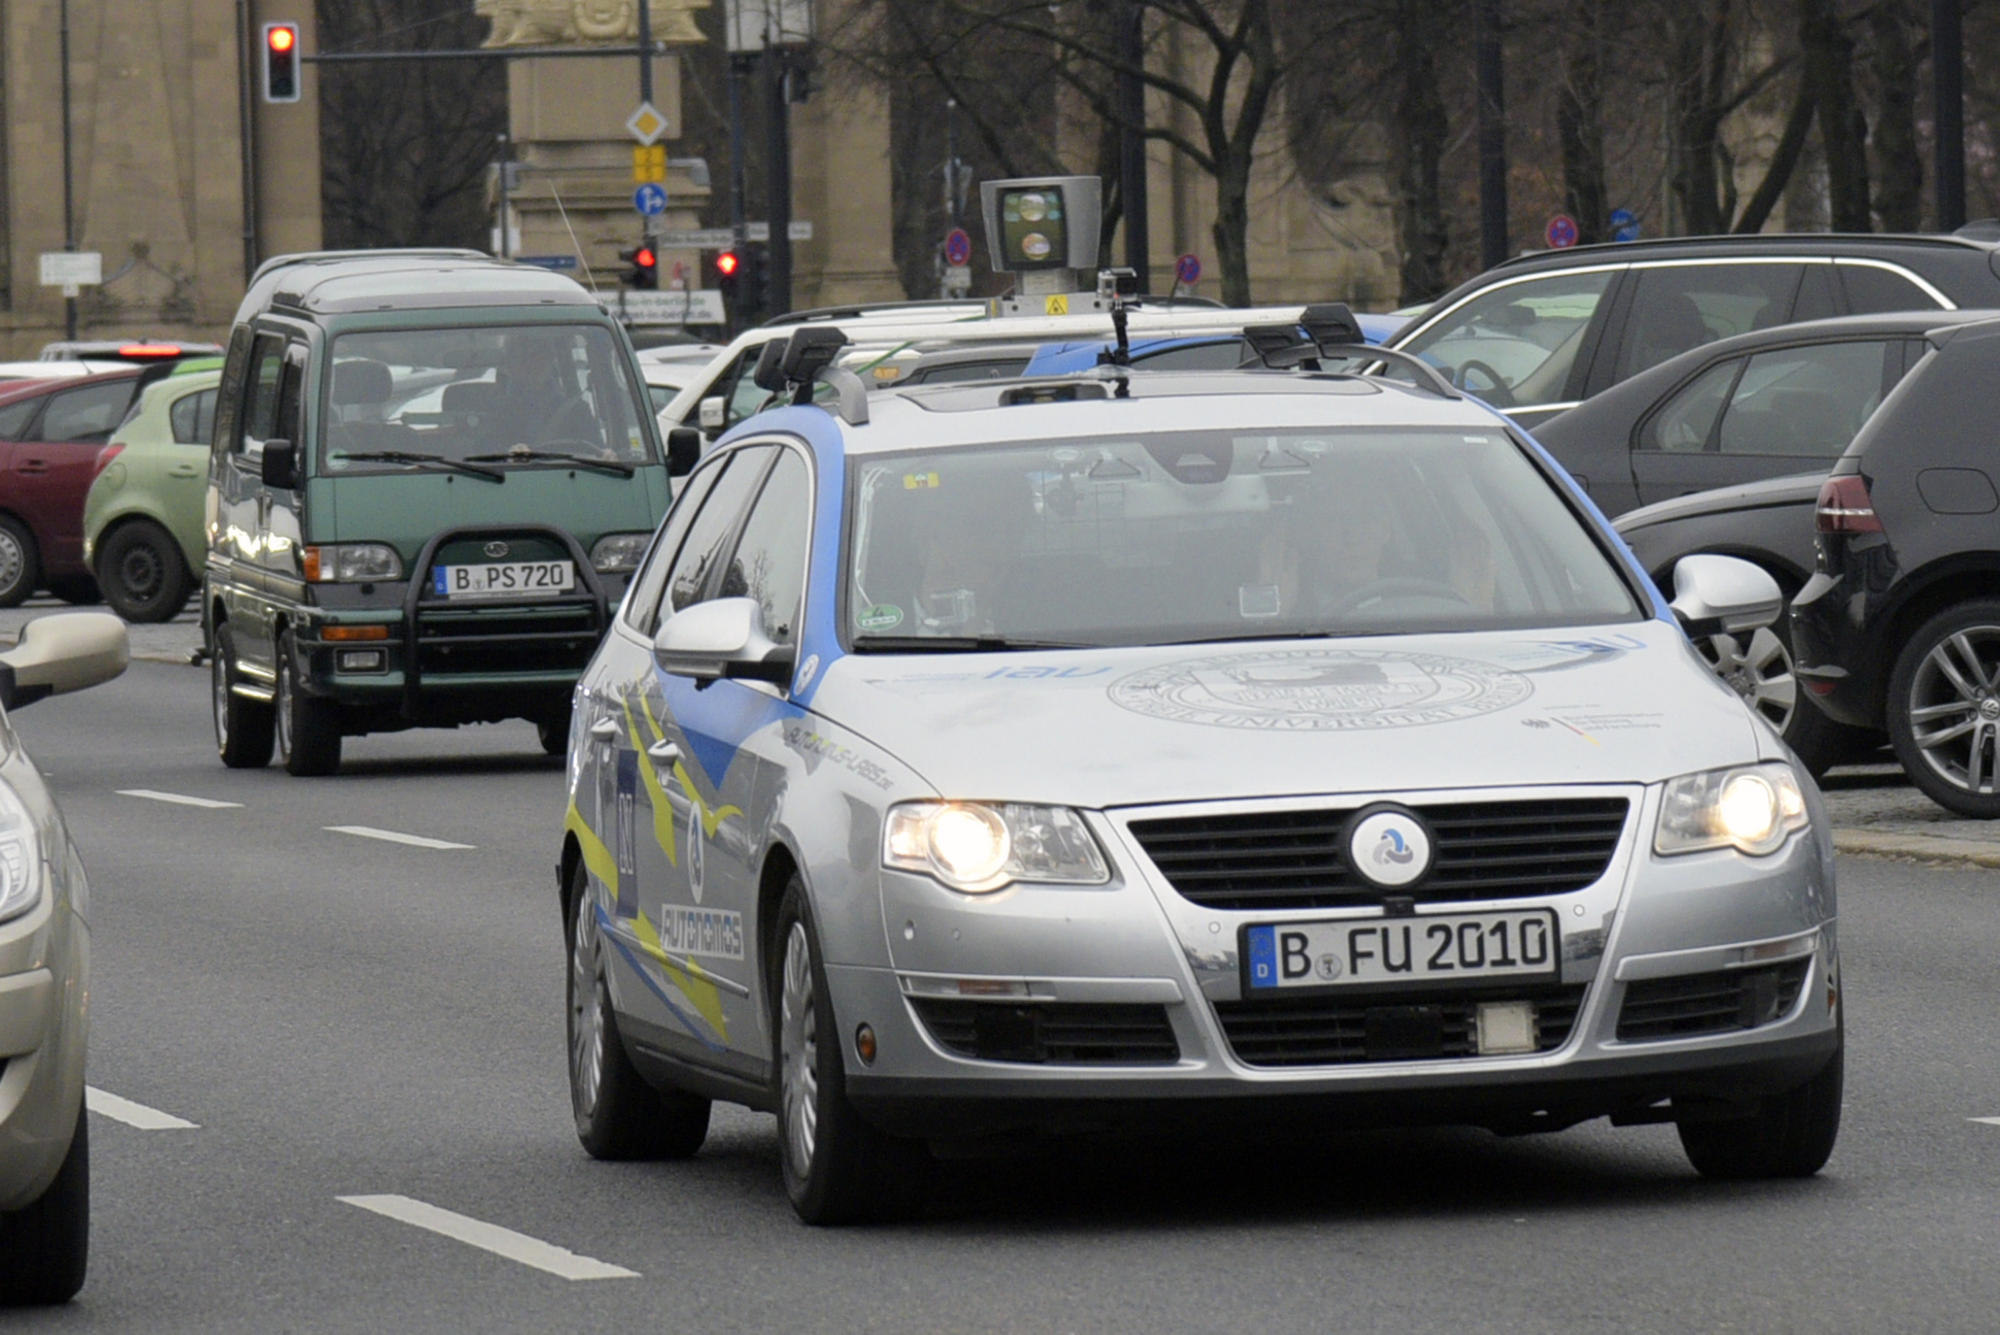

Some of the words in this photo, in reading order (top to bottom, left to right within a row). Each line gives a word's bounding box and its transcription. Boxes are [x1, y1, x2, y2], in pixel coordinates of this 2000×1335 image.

[456, 568, 470, 590] B
[486, 566, 516, 589] PS
[520, 563, 564, 588] 720
[1280, 931, 1312, 979] B
[1348, 925, 1413, 975] FU
[1426, 918, 1547, 971] 2010
[1257, 963, 1269, 978] D
